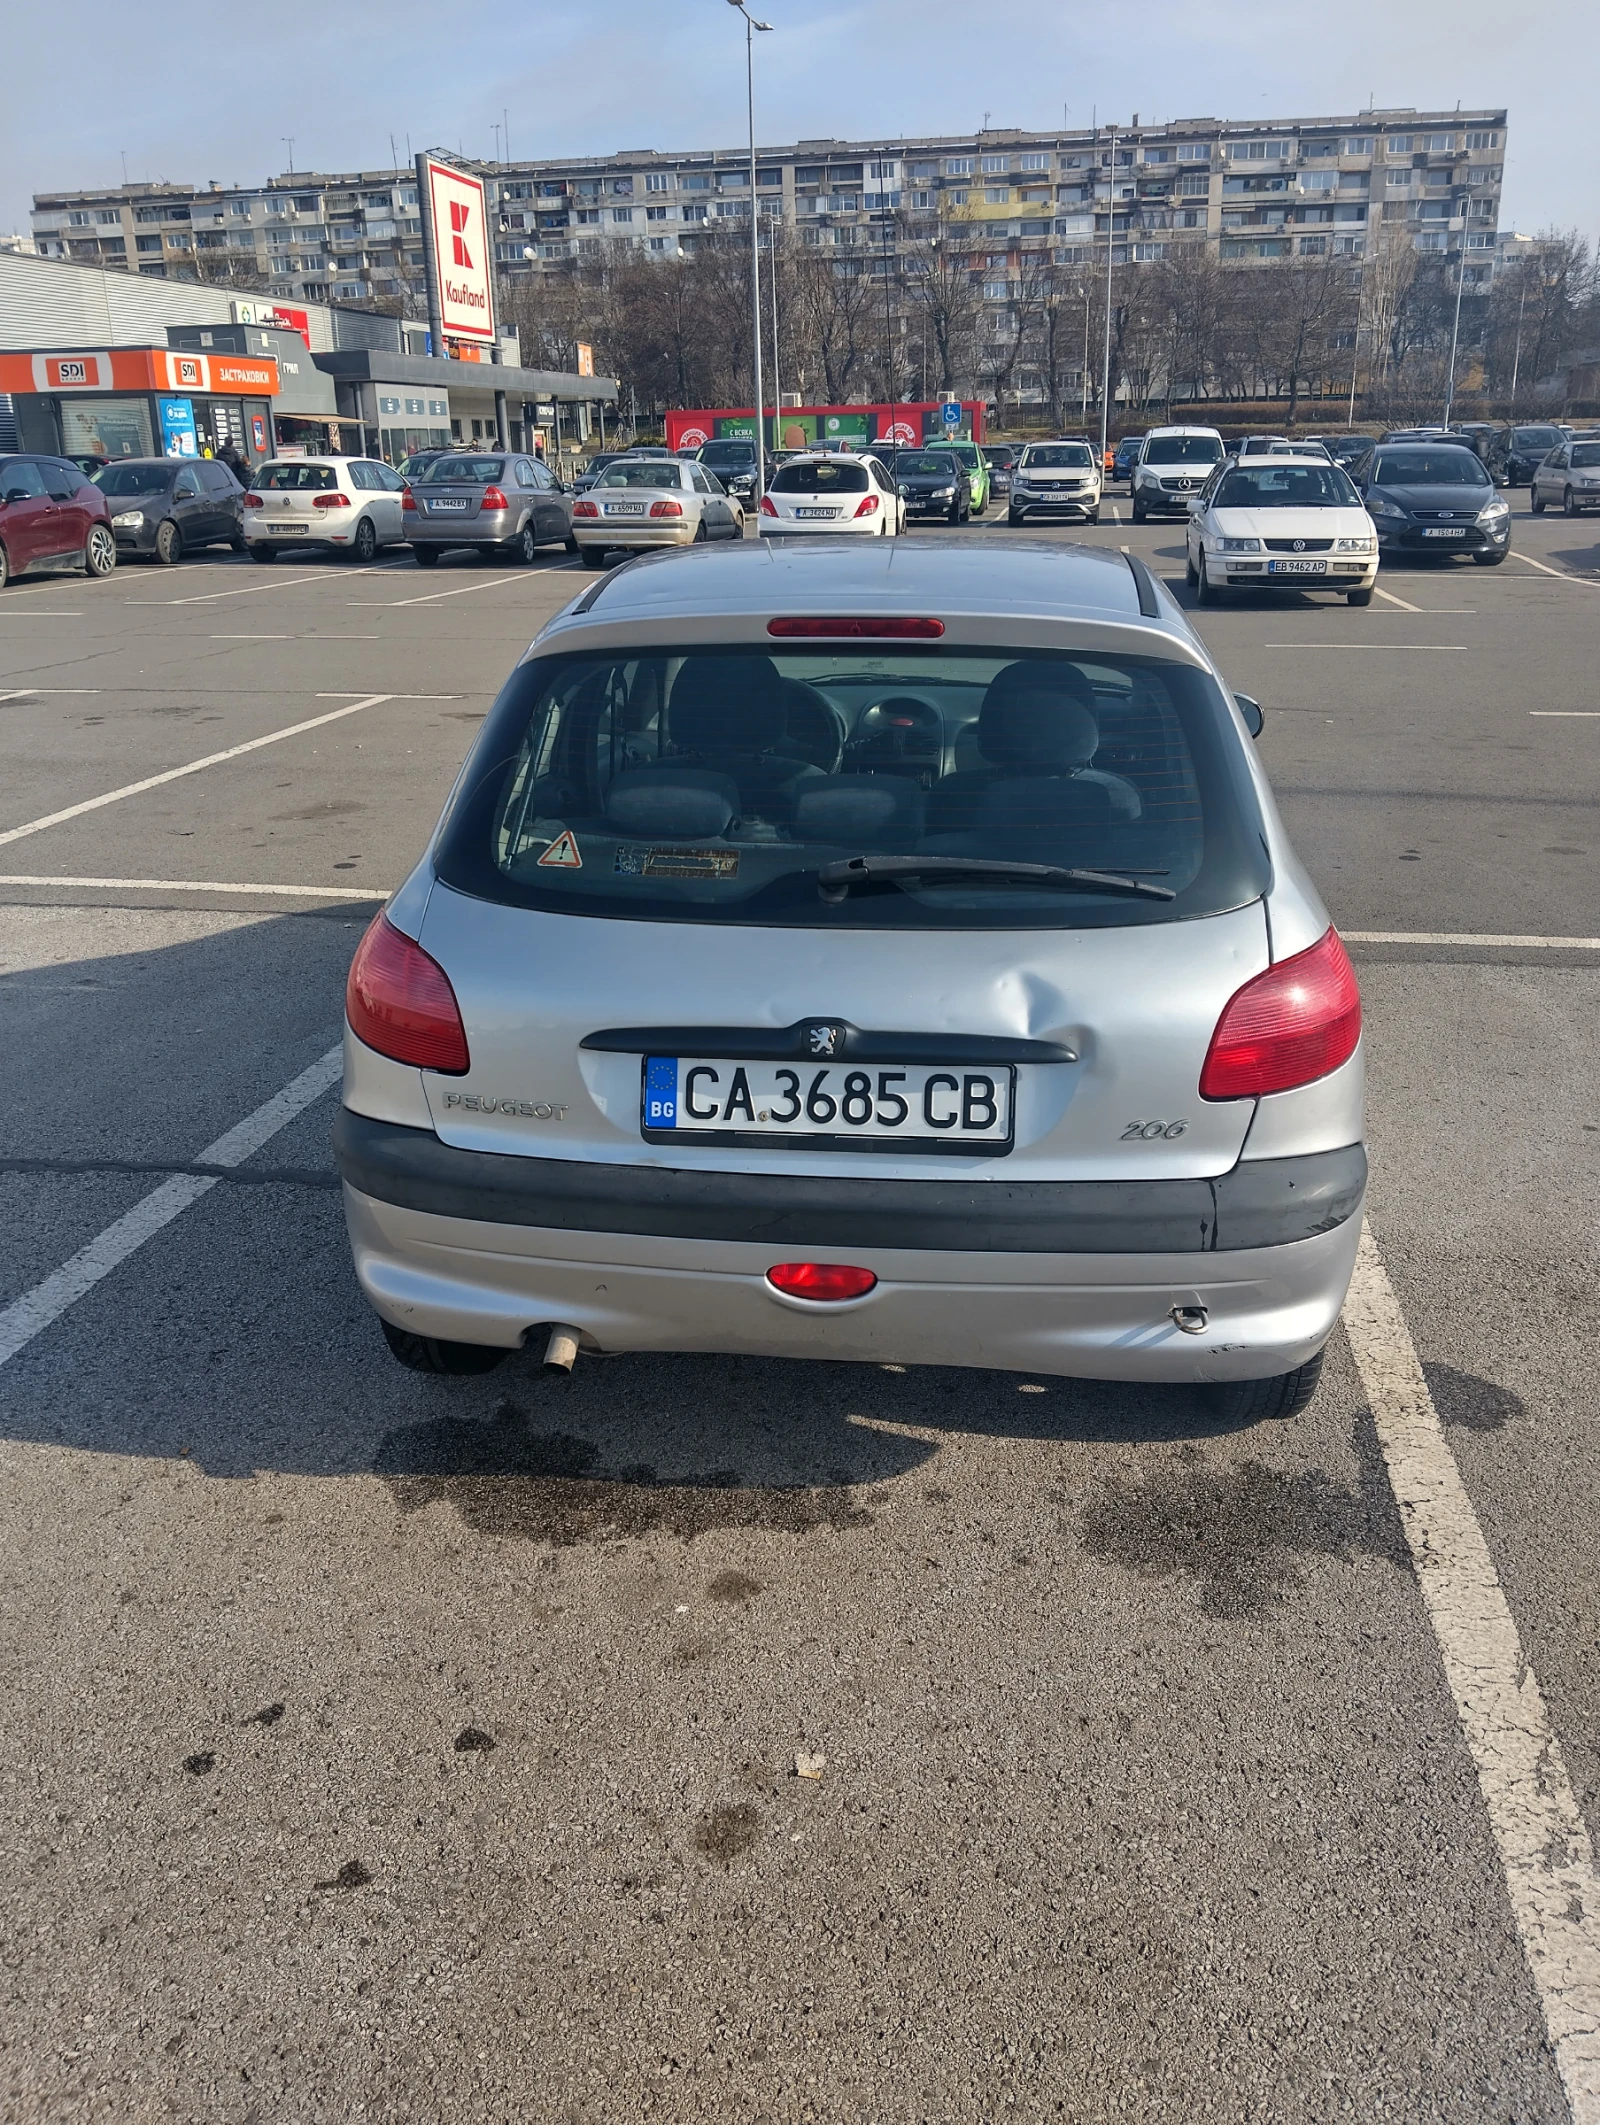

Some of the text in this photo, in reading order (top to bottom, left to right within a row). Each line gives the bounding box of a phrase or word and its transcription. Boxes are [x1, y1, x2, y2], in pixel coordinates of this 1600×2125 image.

[445, 279, 485, 308] Kaufland
[60, 363, 84, 377] SDI
[182, 363, 195, 378] SDI
[219, 367, 270, 384] ЗАСТРАХОВКИ
[282, 362, 299, 375] ГРИЛ
[1275, 562, 1325, 571] EB 9462 AP
[685, 1066, 997, 1129] CA 3685 CB
[443, 1092, 568, 1121] PEUGEOT
[651, 1101, 674, 1118] BG
[1119, 1119, 1190, 1141] 206
